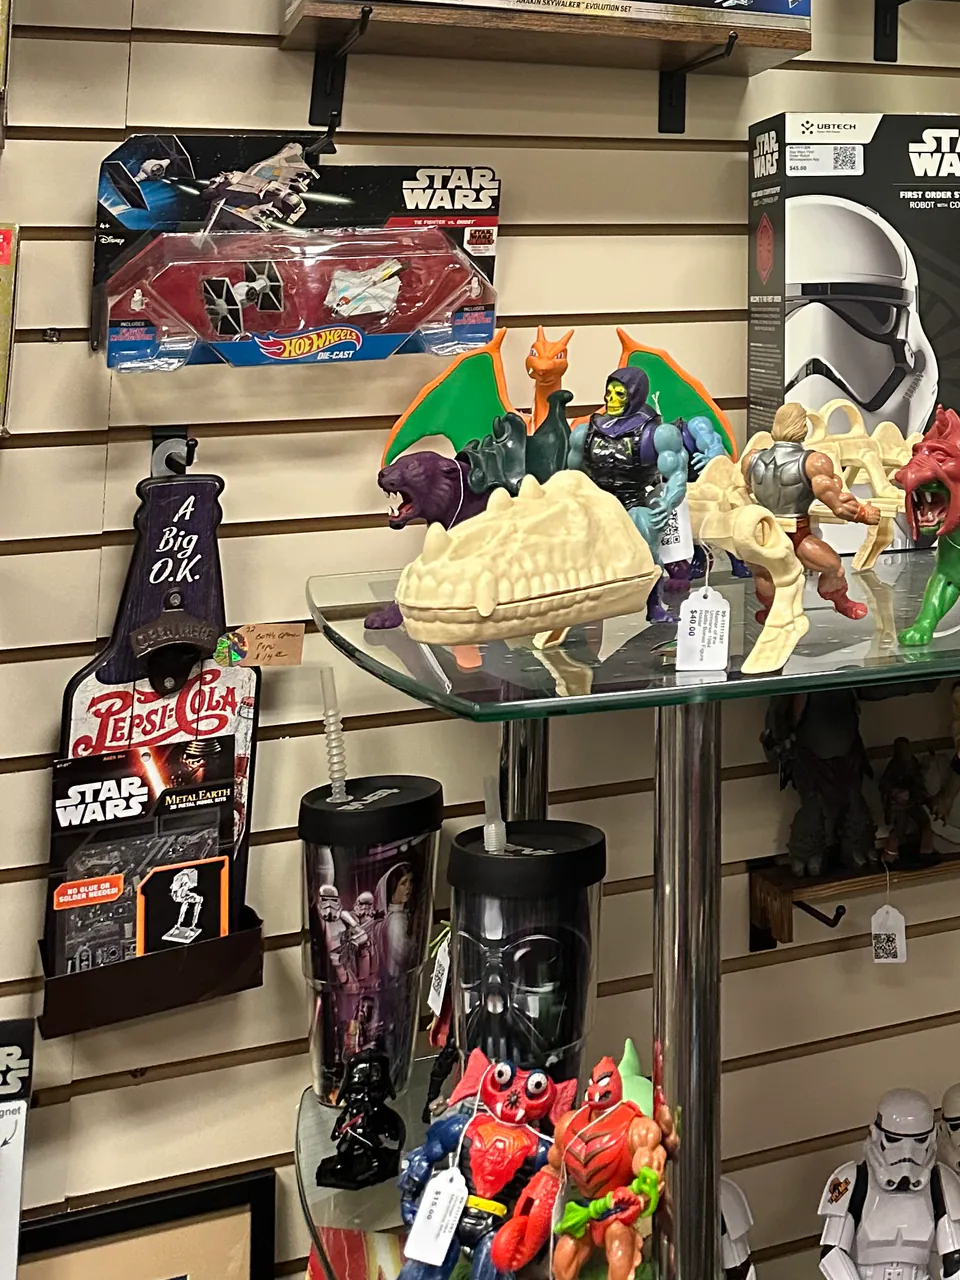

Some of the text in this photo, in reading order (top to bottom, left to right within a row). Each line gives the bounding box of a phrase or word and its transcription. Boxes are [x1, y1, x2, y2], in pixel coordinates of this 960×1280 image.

[585, 3, 619, 13] EVOLUTION
[620, 5, 632, 13] SET
[753, 130, 779, 157] STAR
[753, 151, 779, 179] WARS
[402, 169, 499, 189] STAR
[402, 189, 498, 209] WARS
[900, 191, 922, 199] FIRST
[925, 191, 952, 199] ORDER
[909, 201, 935, 209] ROBOT
[99, 235, 125, 246] Disney
[317, 350, 355, 360] DIE-CAST
[173, 495, 196, 523] A
[155, 526, 199, 559] Big
[149, 554, 202, 585] O.K.
[688, 610, 697, 637] $40.00
[55, 776, 148, 808] STAR
[165, 788, 231, 806] METAL EARTH
[56, 795, 148, 828] WARS
[58, 887, 118, 903] SOLDER NEEDED!
[80, 884, 98, 892] GLUE
[427, 1190, 441, 1220] $15.00
